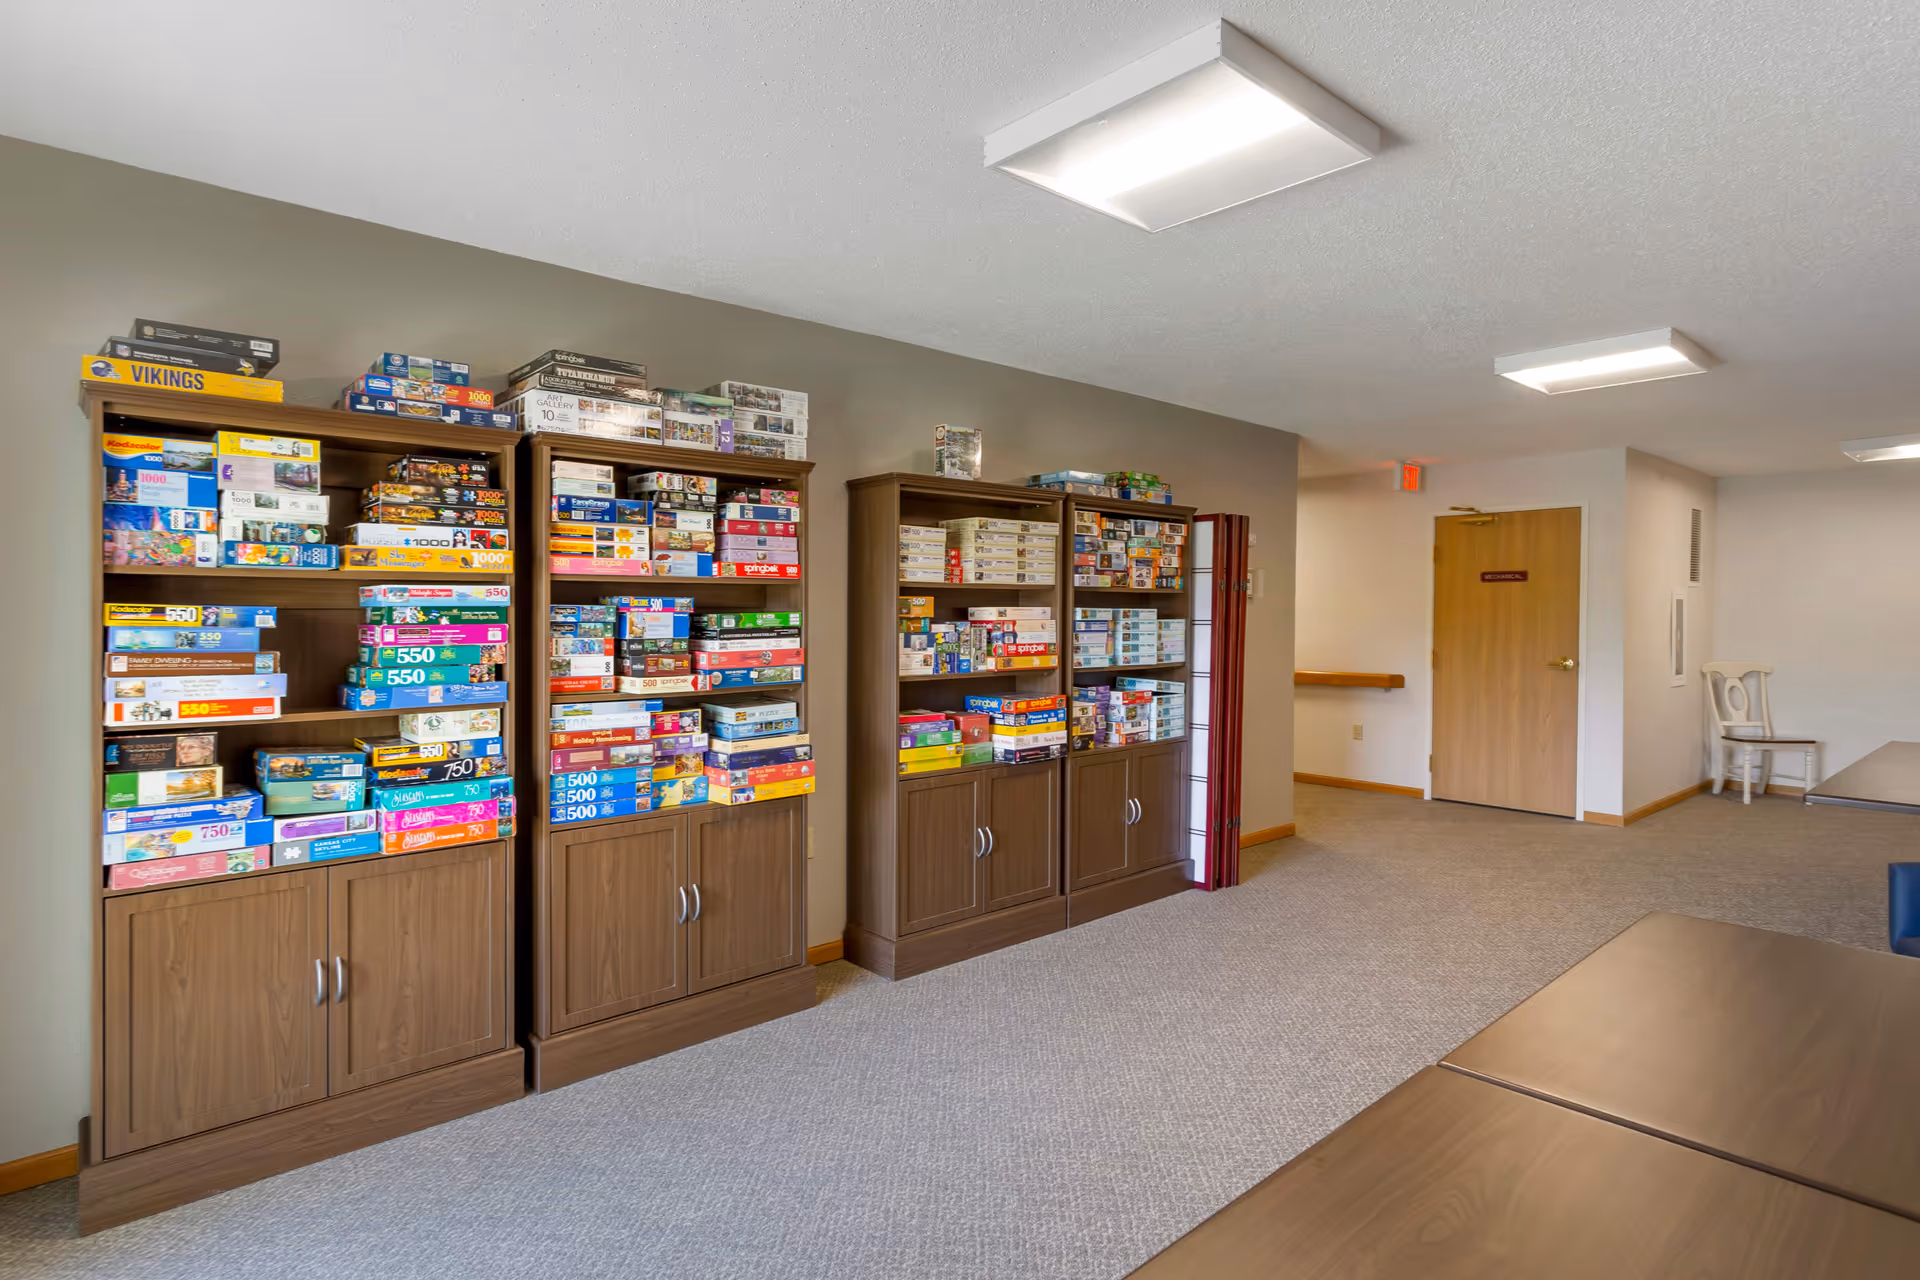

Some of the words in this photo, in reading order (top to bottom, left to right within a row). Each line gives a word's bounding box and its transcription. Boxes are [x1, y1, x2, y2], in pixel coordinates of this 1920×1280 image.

[555, 354, 585, 363] springbok
[131, 364, 204, 390] VIKINGS
[545, 377, 576, 385] ADORATION
[557, 368, 615, 384] TUTANKHAMUN
[468, 392, 490, 402] 1000
[537, 400, 574, 409] GALLERY
[542, 410, 554, 421] 10
[721, 430, 731, 443] 12
[107, 440, 161, 450] Kodacolor
[140, 473, 166, 484] 1000
[1404, 464, 1419, 491] EXIT
[476, 490, 500, 501] 1000
[572, 498, 609, 508] EasyGrasp
[475, 510, 499, 521] 1000
[412, 539, 450, 547] 1000
[312, 548, 320, 564] 1000
[389, 550, 406, 560] Sky
[470, 552, 504, 568] 1000
[379, 558, 426, 568] Messenger
[744, 565, 779, 573] springbok
[486, 588, 508, 597] 550
[650, 599, 662, 611] 500
[913, 598, 926, 606] 500
[165, 607, 197, 622] 550
[1017, 644, 1045, 654] springbok
[397, 647, 435, 664] 550
[387, 669, 425, 684] 550
[642, 679, 657, 687] 500
[180, 703, 210, 715] 550
[970, 699, 999, 709] springbok
[573, 736, 595, 744] Holiday
[596, 735, 632, 743] Homecoming
[420, 744, 443, 758] 550
[378, 767, 432, 780] Kodacolor
[444, 759, 473, 780] 750
[568, 772, 597, 787] 500
[464, 784, 480, 796] 750
[567, 788, 596, 803] 500
[468, 804, 484, 816] 750
[567, 805, 597, 820] 500
[200, 824, 229, 838] 750
[467, 825, 484, 836] 750
